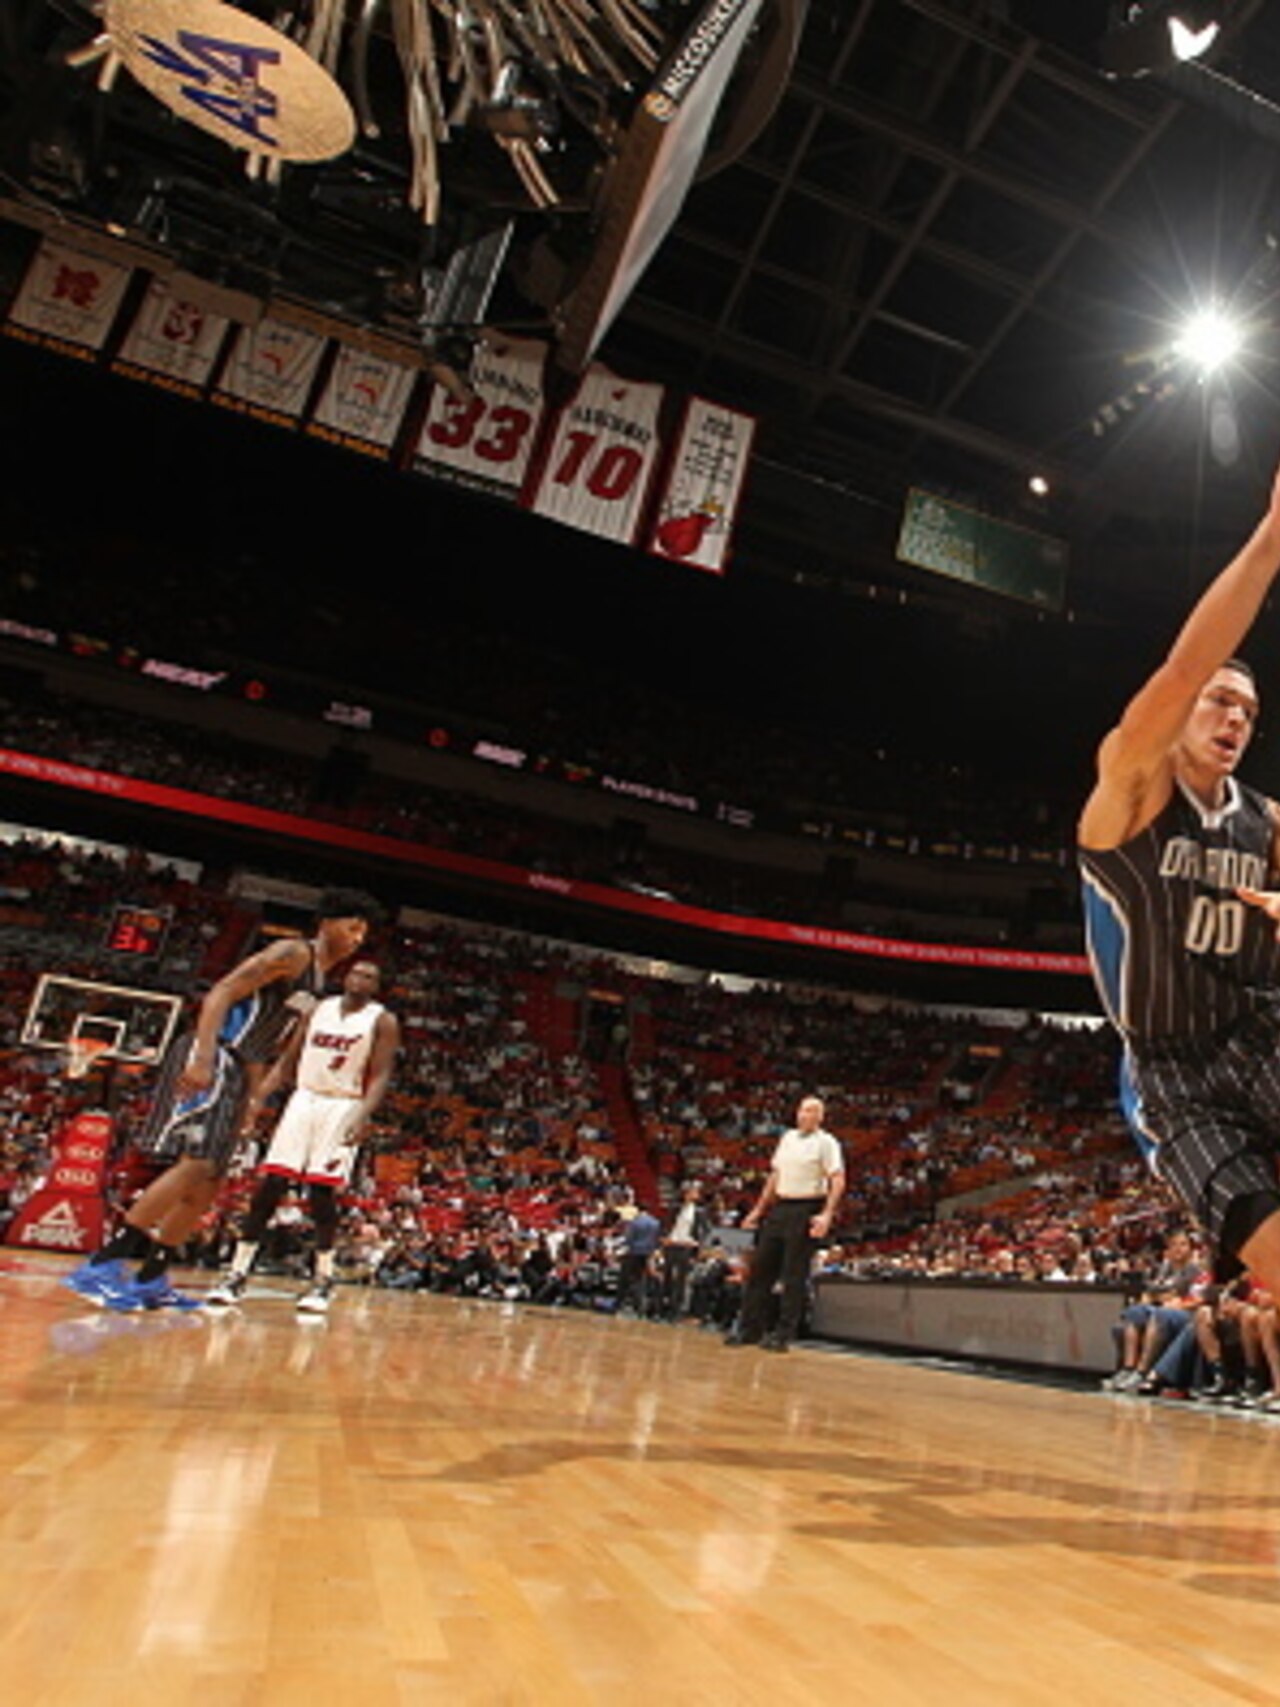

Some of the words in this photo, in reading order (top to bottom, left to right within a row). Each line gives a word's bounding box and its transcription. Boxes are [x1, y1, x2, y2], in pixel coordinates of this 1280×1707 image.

[427, 395, 532, 462] 33
[554, 431, 644, 500] 10
[1184, 894, 1245, 955] 00
